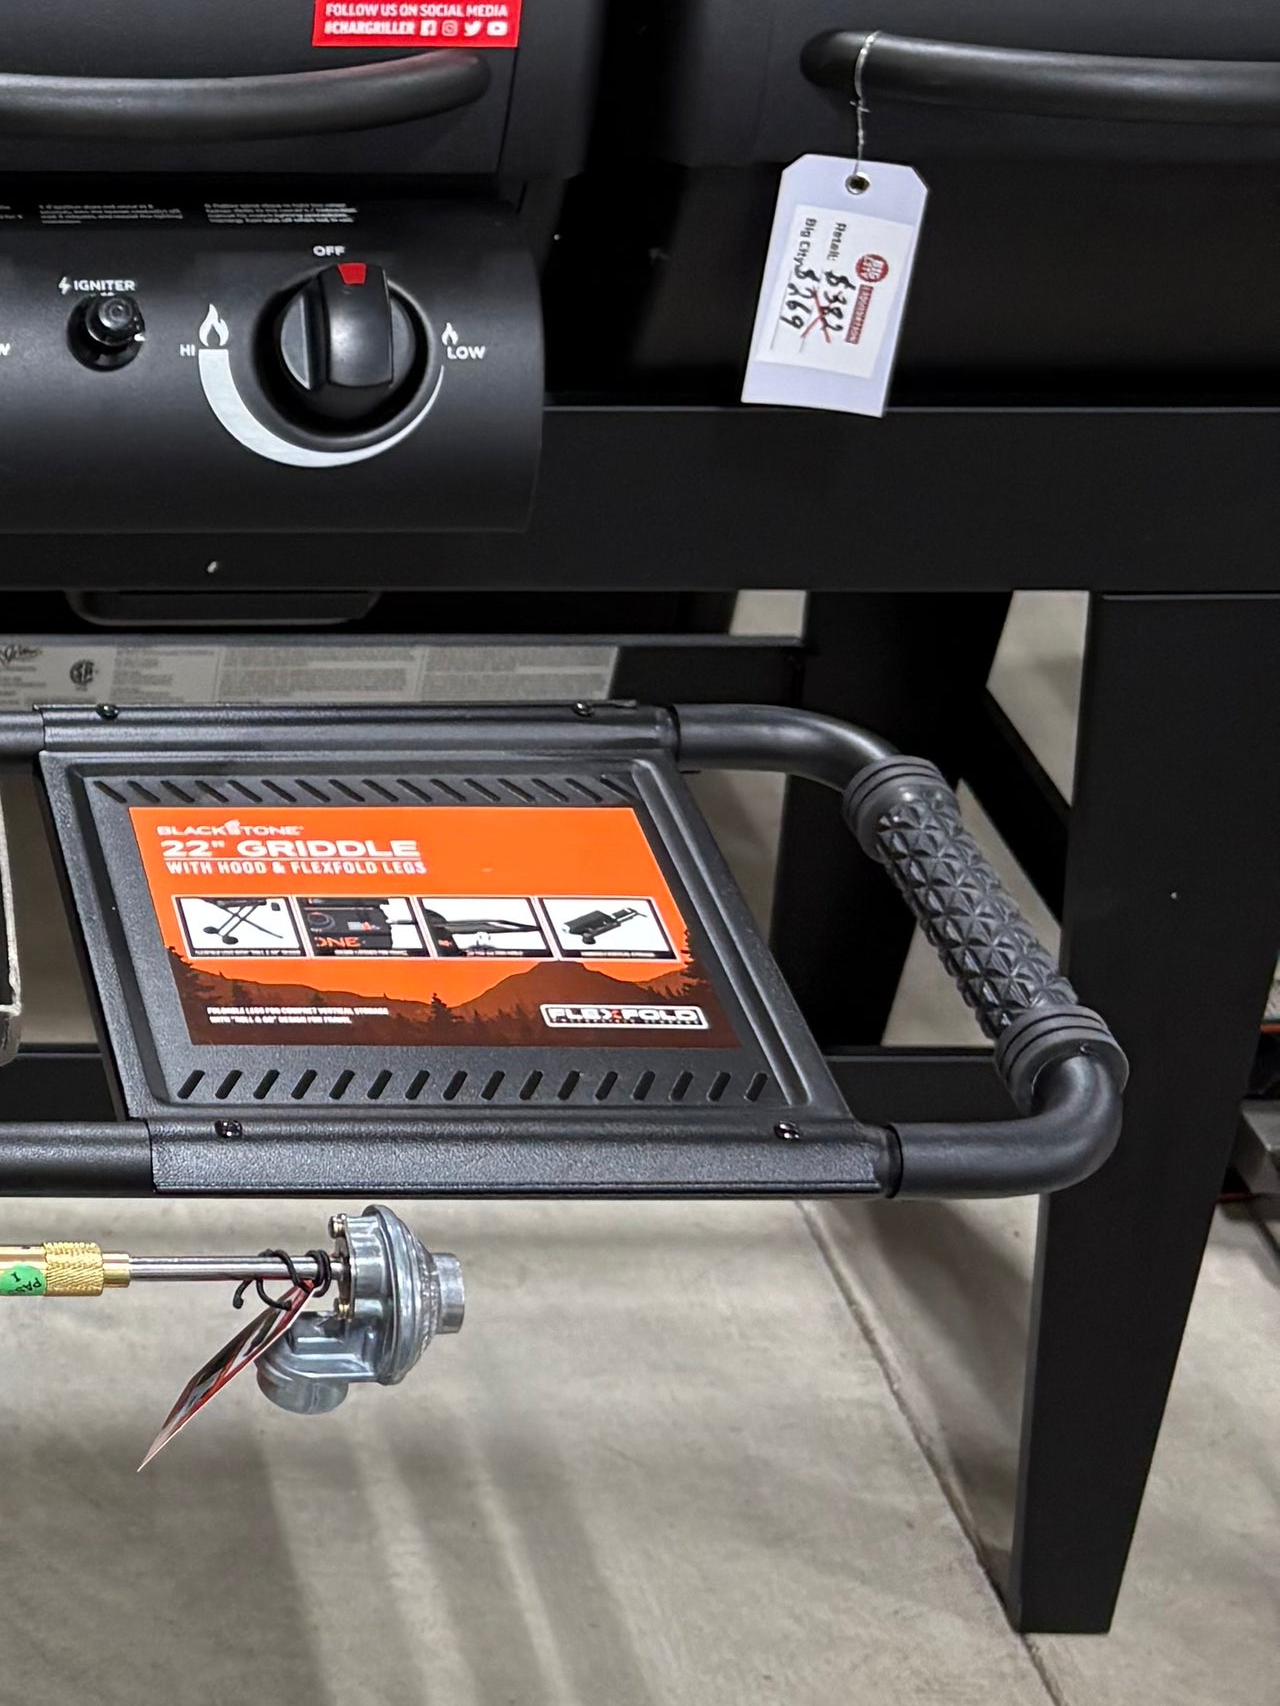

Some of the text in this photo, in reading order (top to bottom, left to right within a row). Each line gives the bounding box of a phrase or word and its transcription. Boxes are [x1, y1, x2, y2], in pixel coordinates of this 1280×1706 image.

[326, 3, 508, 17] FOLLOW US ON SOCIAL MEDIA
[324, 21, 415, 34] #CHARGRILLER
[313, 245, 345, 257] OFF
[73, 279, 135, 292] IGNITER
[180, 345, 196, 357] HI
[447, 346, 485, 360] LOW
[156, 824, 299, 836] BLACKSTONE
[160, 840, 421, 858] 22" GRIDDLE
[165, 861, 427, 875] WITH HOOD & FLEXFOLD LEGS
